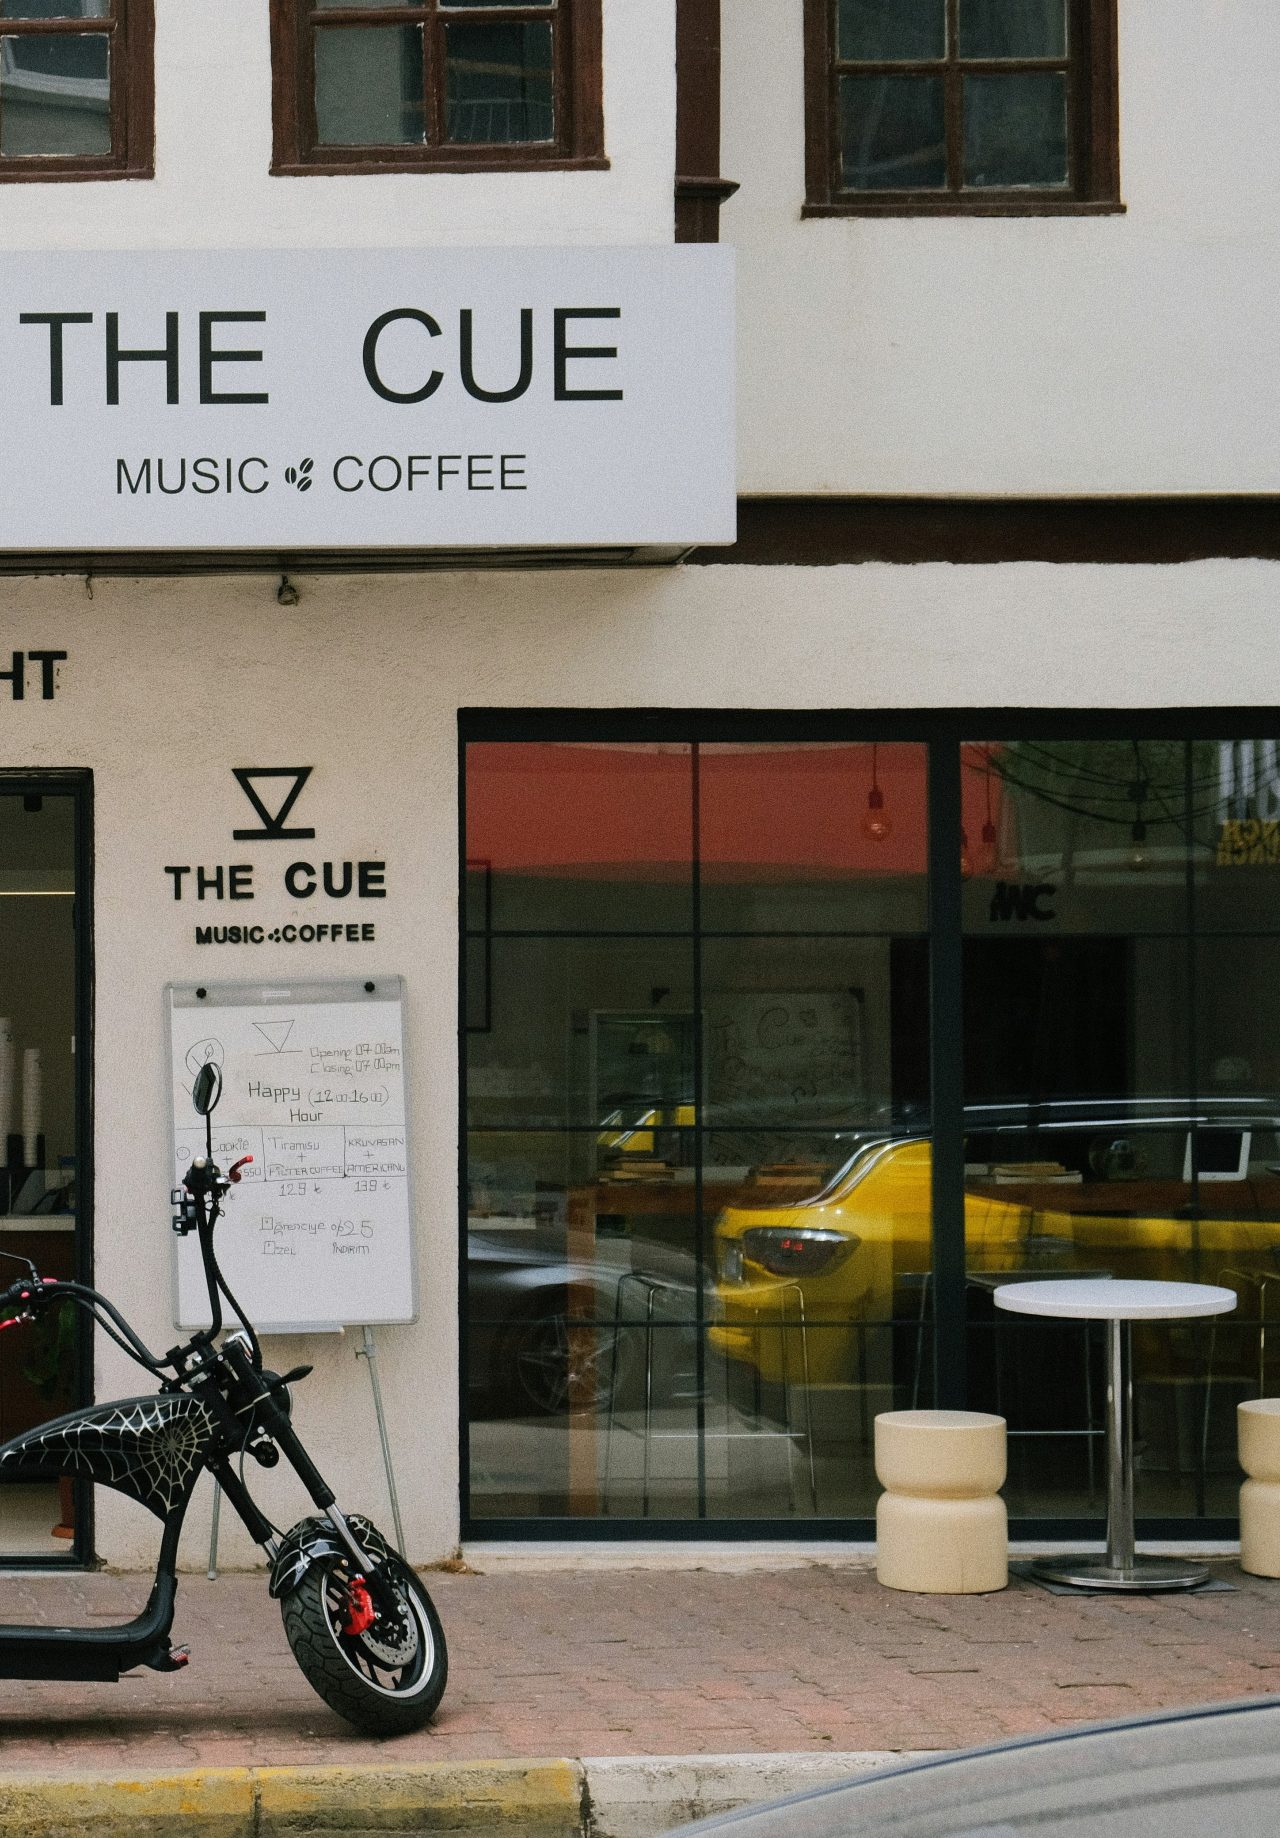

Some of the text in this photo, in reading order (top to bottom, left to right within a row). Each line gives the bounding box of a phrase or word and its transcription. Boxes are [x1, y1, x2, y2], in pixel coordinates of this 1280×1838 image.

[20, 308, 623, 405] THE CUE
[117, 455, 526, 494] MUSIC COFFEE
[164, 861, 387, 900] THE CUE
[195, 924, 375, 944] MUSIC COFFEE
[248, 1081, 301, 1103] Happy
[290, 1109, 324, 1122] Hour
